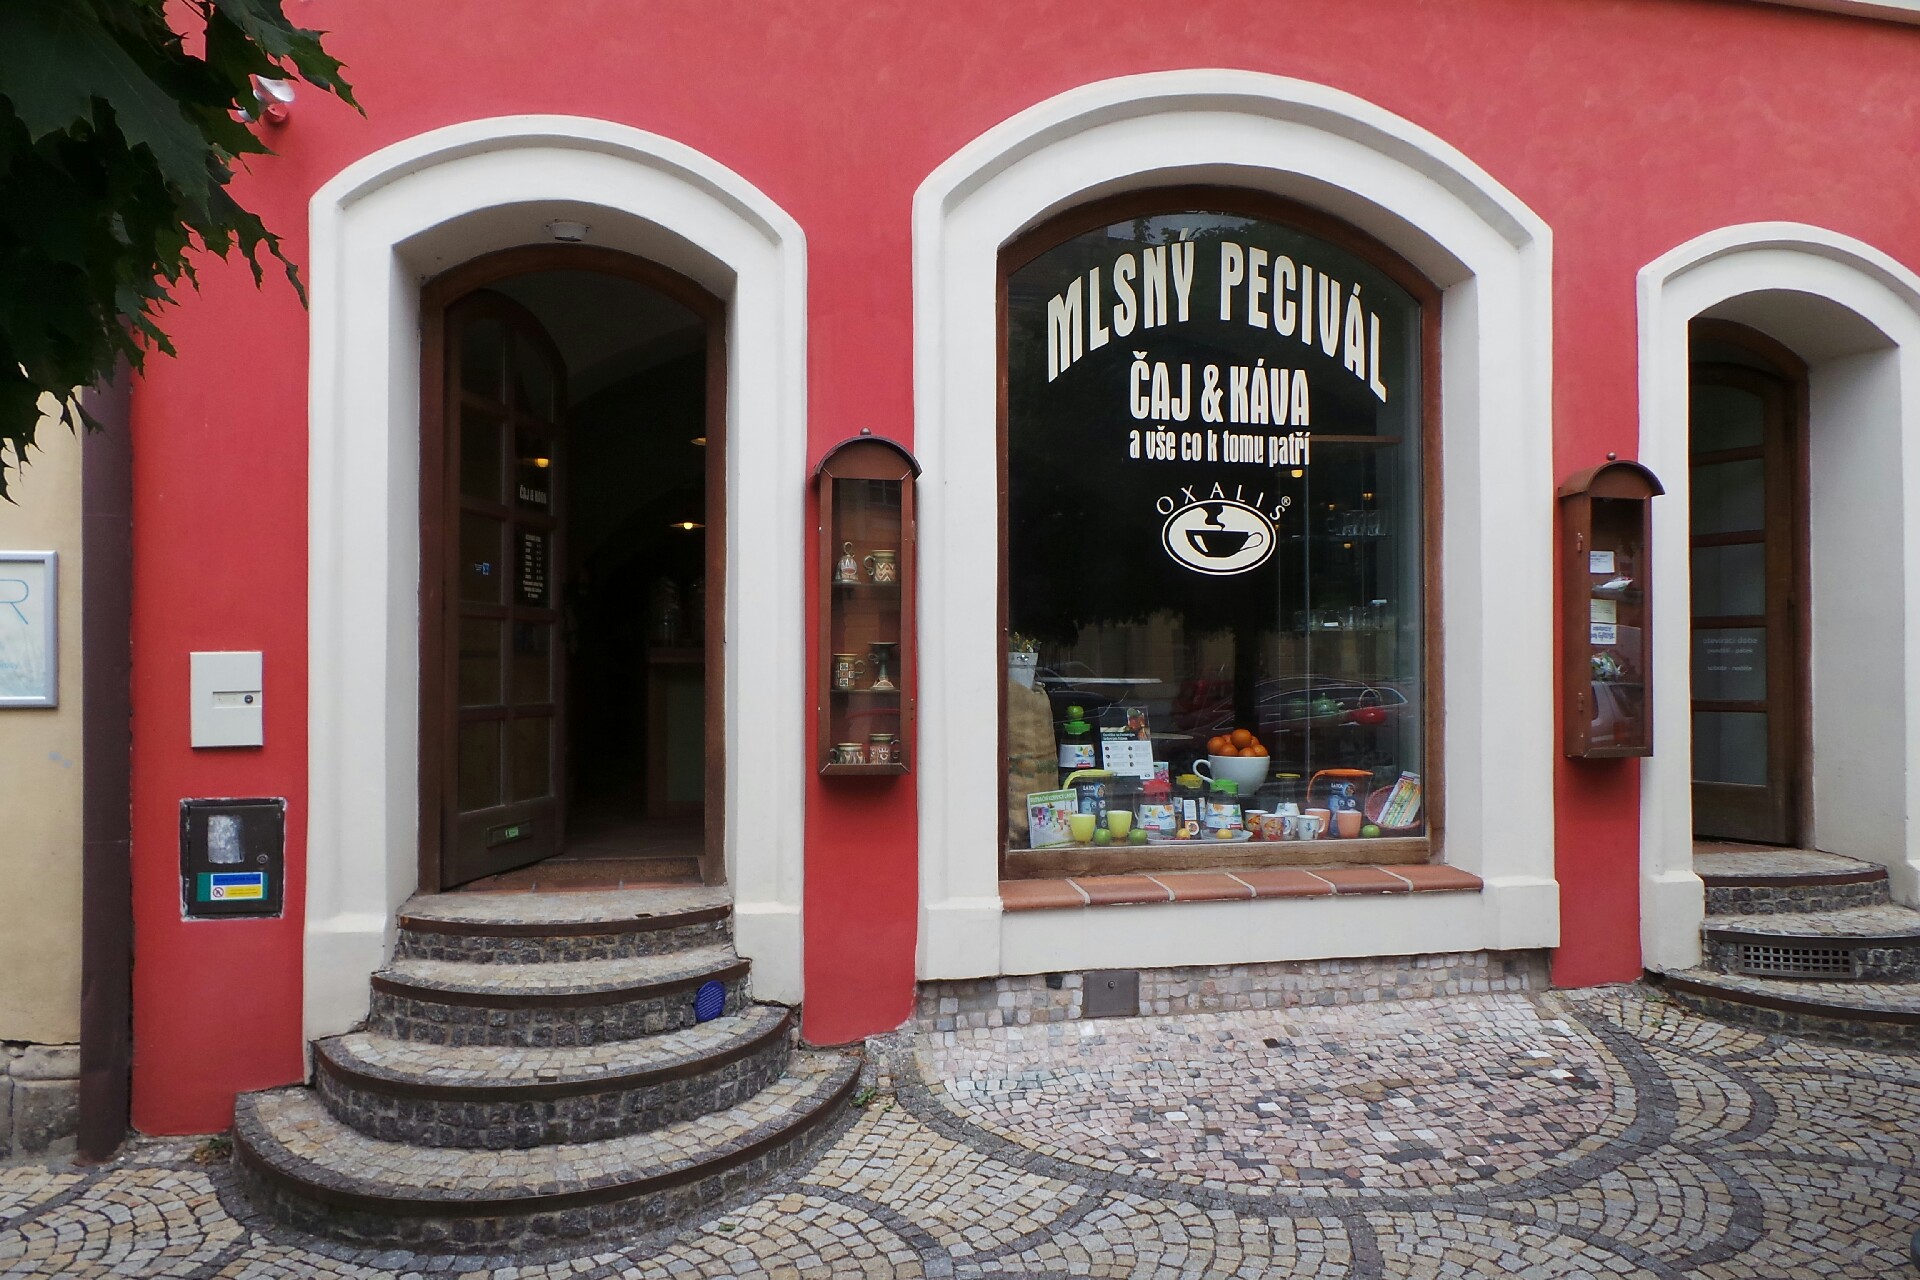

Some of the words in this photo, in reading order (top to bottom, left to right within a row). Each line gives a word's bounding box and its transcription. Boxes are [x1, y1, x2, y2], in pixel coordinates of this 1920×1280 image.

[1047, 227, 1195, 383] MLSNÝ
[1219, 240, 1387, 403] PECIVÁL
[1129, 350, 1191, 422] ČAJ
[1200, 364, 1224, 423] &
[1230, 358, 1310, 426] KÁVA
[1129, 431, 1141, 459] a
[1145, 425, 1176, 461] vše
[1181, 432, 1202, 462] co
[1207, 429, 1218, 462] k
[1223, 431, 1264, 464] tomu
[1268, 432, 1310, 468] patří
